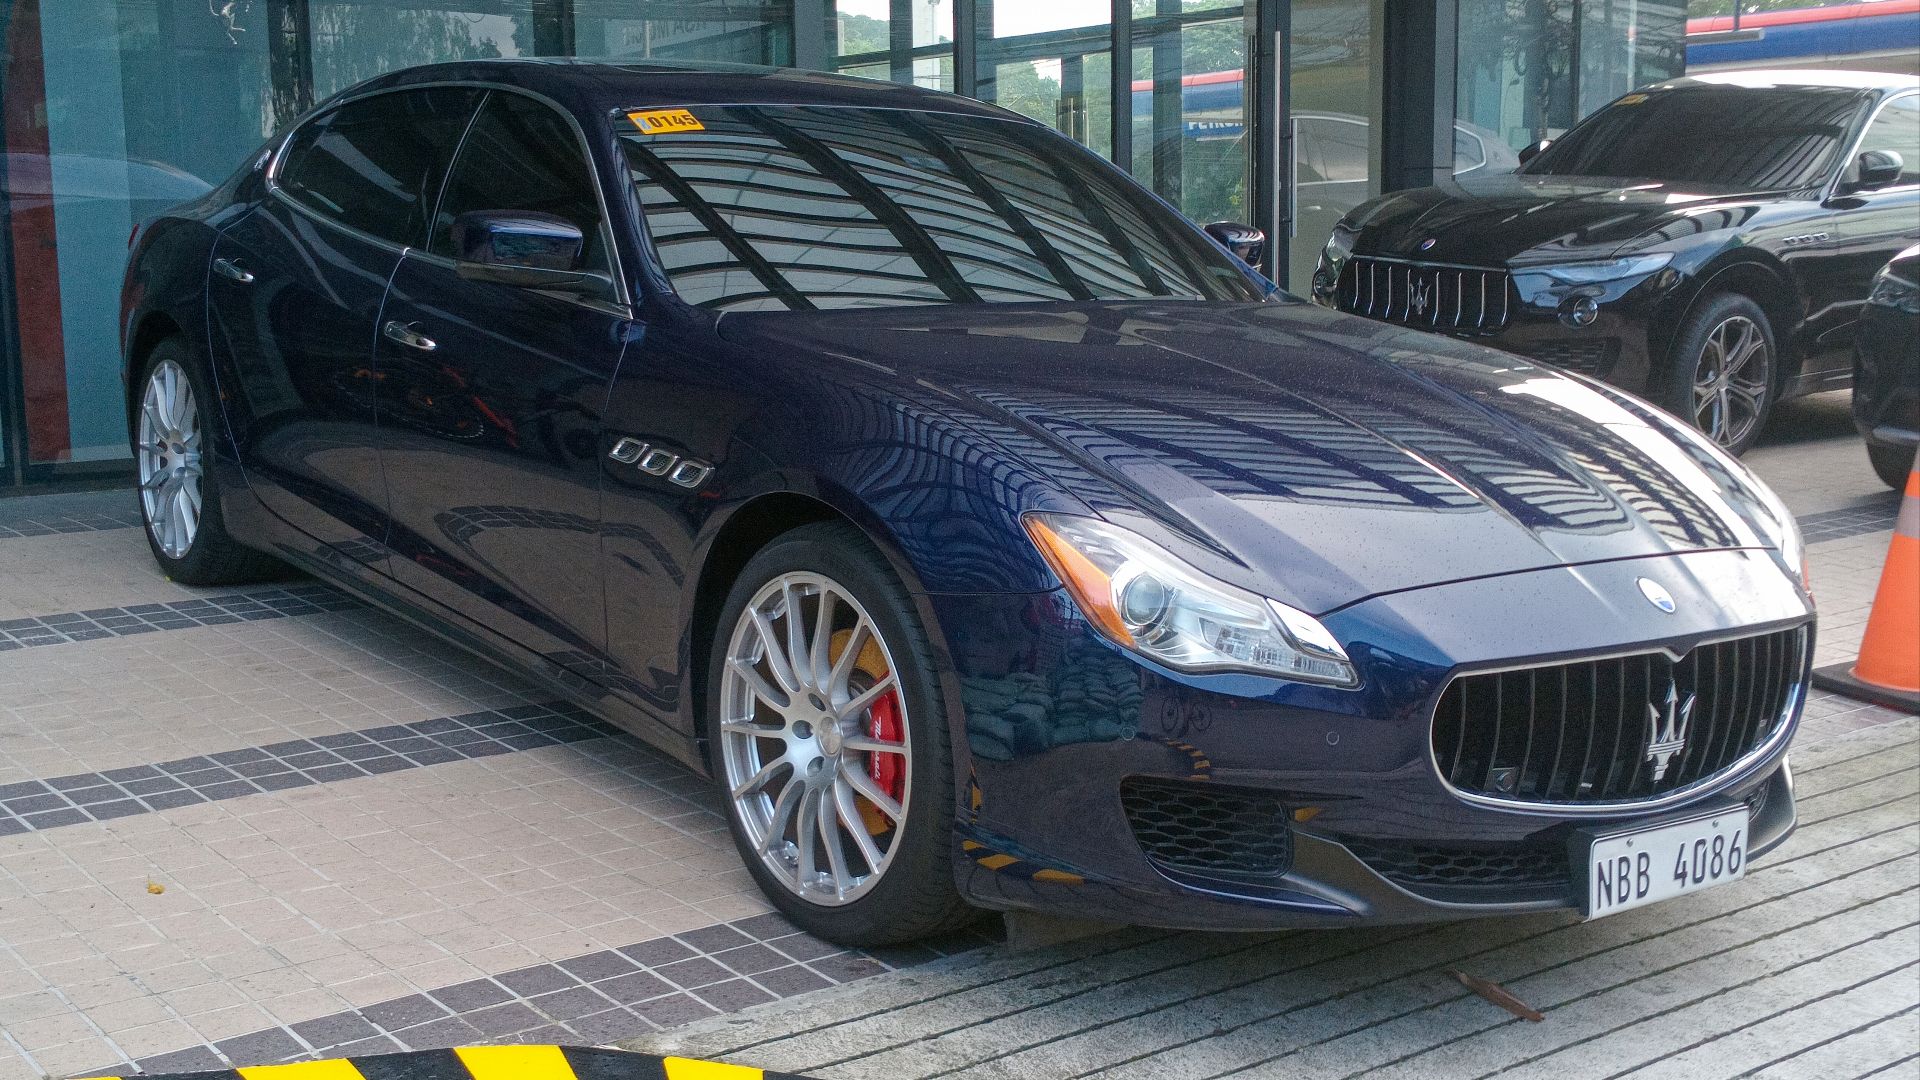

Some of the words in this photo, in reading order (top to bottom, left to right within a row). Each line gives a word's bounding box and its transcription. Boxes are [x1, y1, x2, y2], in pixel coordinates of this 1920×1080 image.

[647, 114, 698, 128] 0145
[874, 716, 882, 779] Marati
[1597, 851, 1650, 910] NBB
[1673, 829, 1742, 888] 4086
